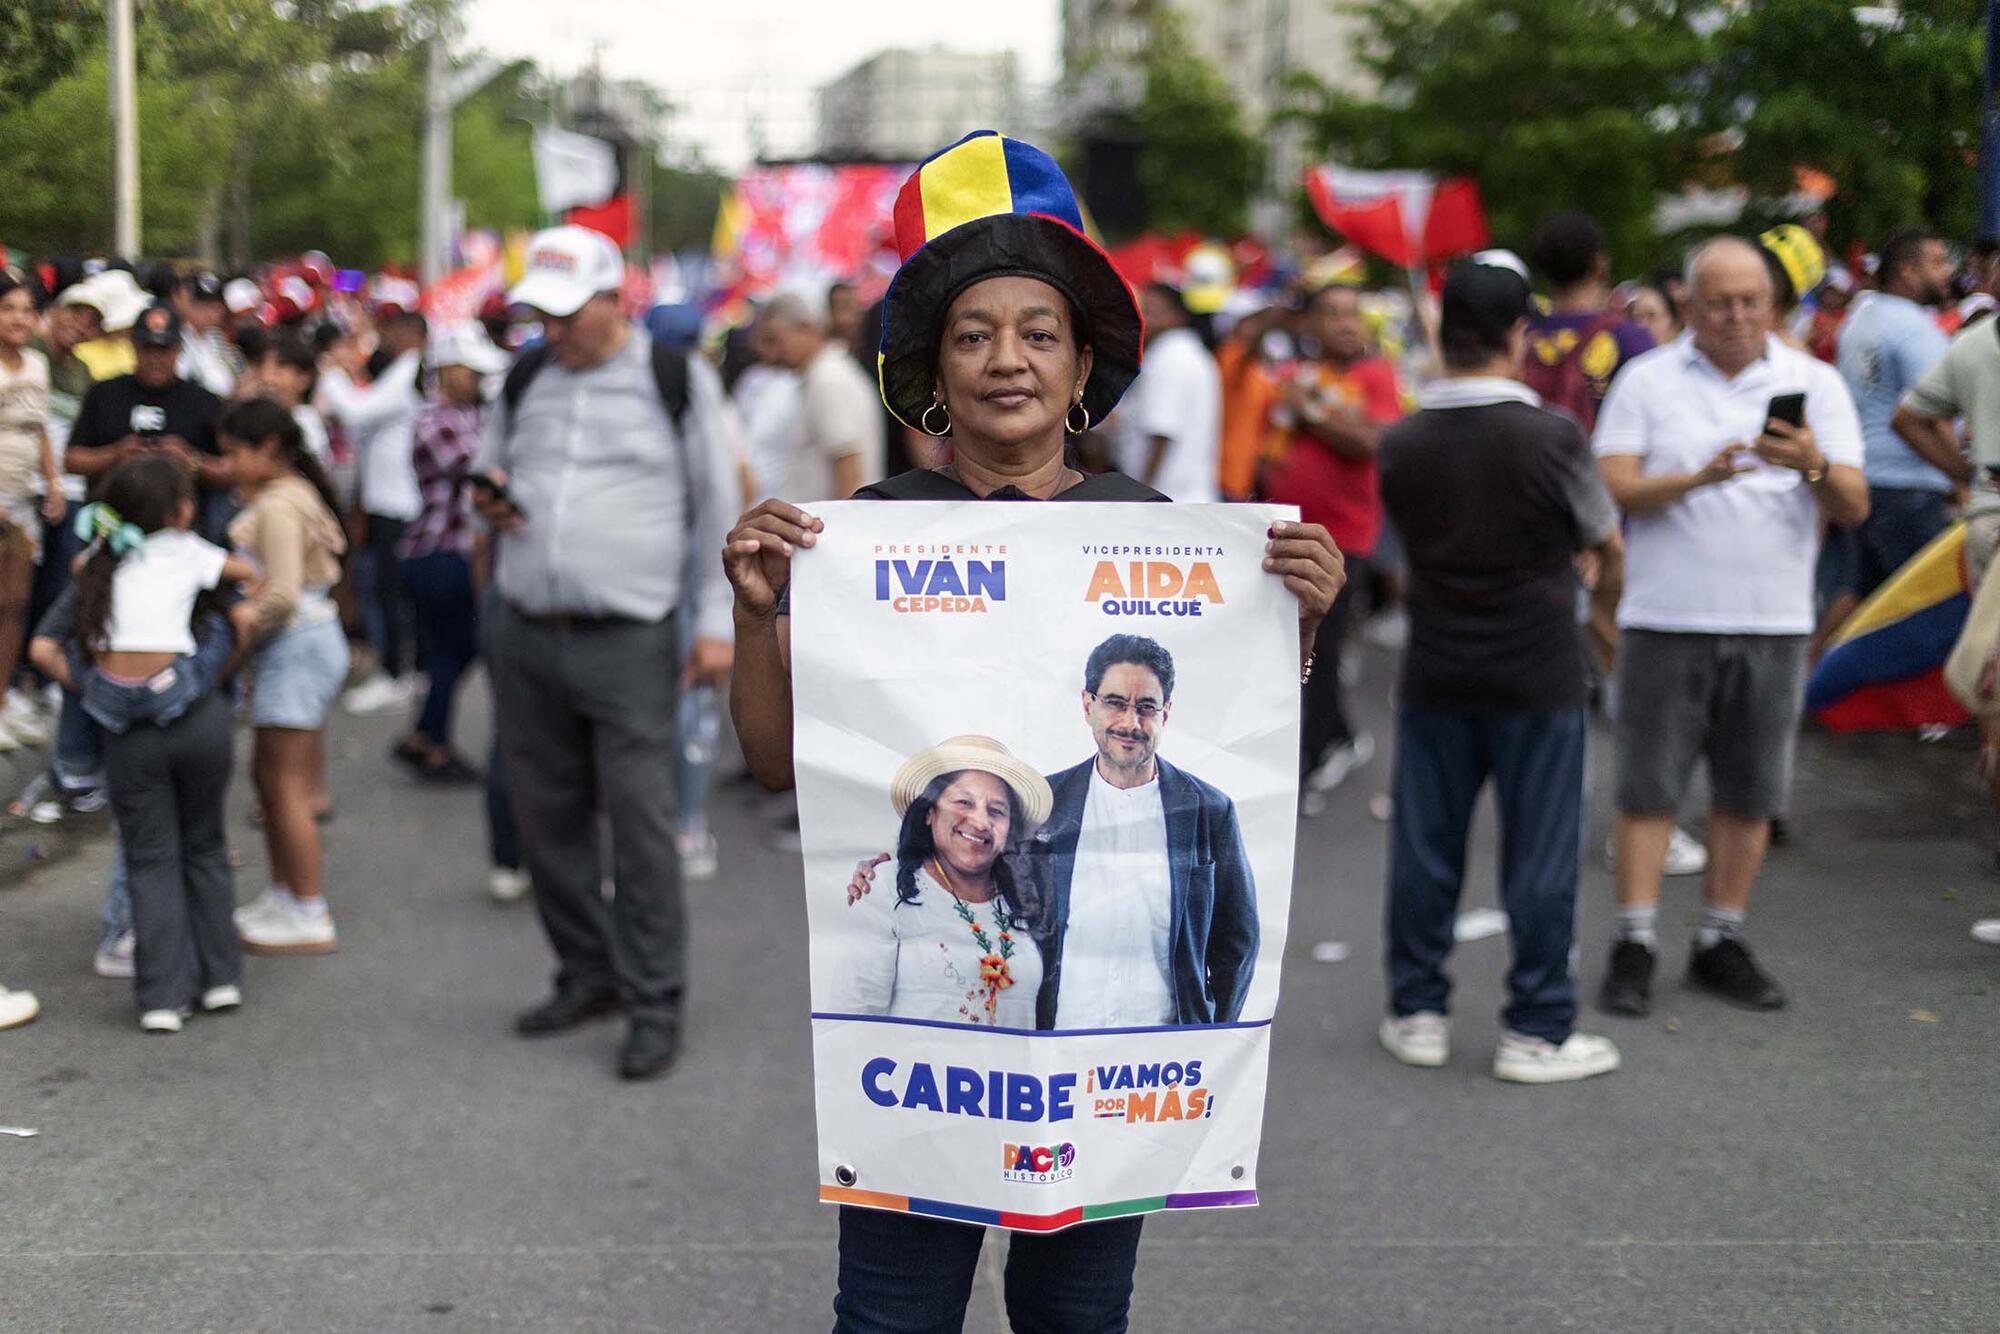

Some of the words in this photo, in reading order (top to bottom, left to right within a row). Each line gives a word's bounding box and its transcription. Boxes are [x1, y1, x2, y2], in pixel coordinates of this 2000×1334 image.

[875, 545, 1007, 554] PRESIDENTE
[1083, 546, 1224, 556] VICEPRESIDENTA
[875, 555, 1006, 601] IVÁN
[1085, 561, 1225, 604] AIDA
[893, 597, 987, 613] CEPEDA
[1102, 600, 1202, 616] QUILCUÉ
[861, 1057, 1077, 1123] CARIBE
[1087, 1061, 1202, 1093] ¡VAMOS
[1095, 1098, 1125, 1111] POR
[1126, 1082, 1214, 1123] MÁS!
[1004, 1143, 1075, 1173] PACTO
